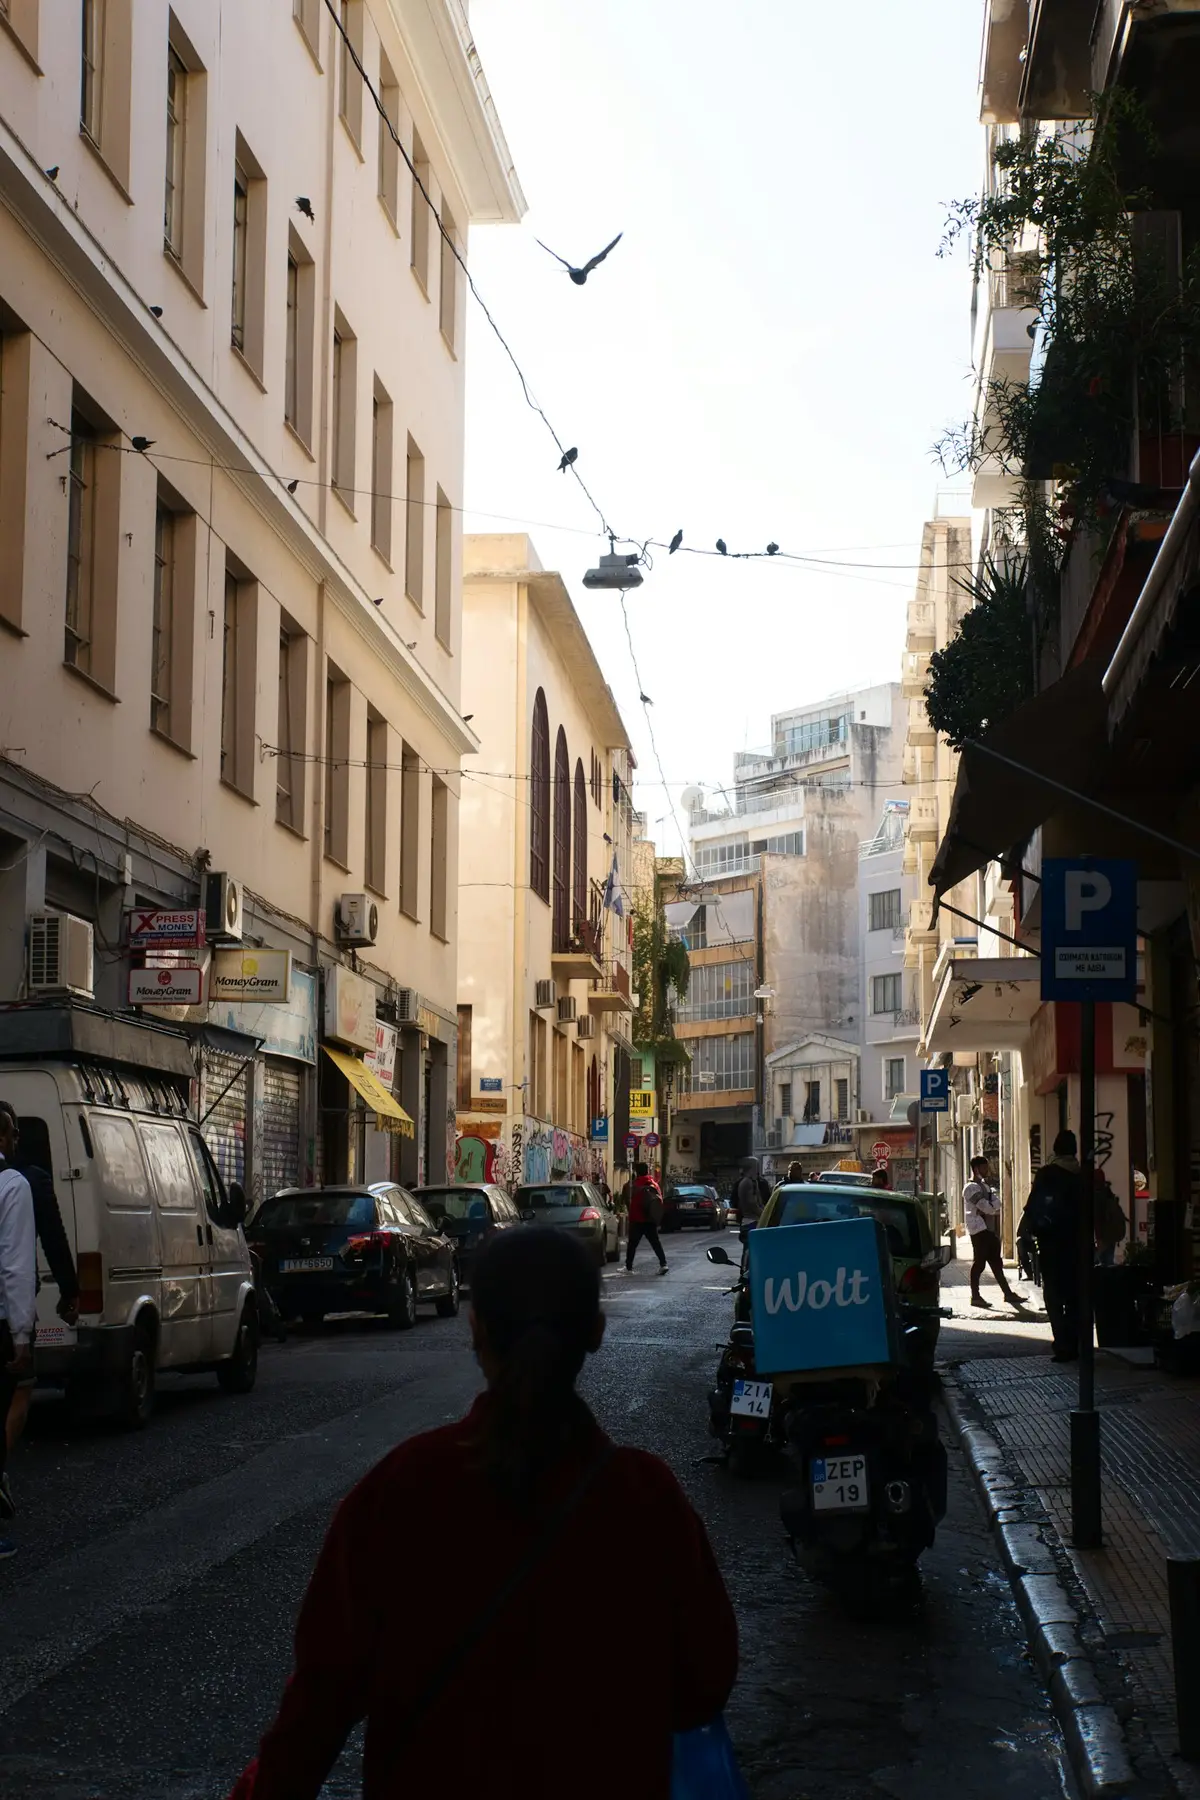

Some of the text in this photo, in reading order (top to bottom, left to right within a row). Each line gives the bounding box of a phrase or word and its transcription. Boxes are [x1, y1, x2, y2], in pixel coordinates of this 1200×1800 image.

[1064, 870, 1112, 931] P
[135, 911, 194, 934] XPRESS
[158, 923, 194, 931] MONEY
[1076, 964, 1085, 972] ΜΕ
[215, 976, 278, 988] MoneyGram
[136, 987, 192, 998] MoneyGram
[927, 1073, 942, 1095] P
[595, 1119, 605, 1131] P
[873, 1146, 889, 1157] STOP
[764, 1266, 871, 1314] Wolt
[744, 1384, 771, 1399] ZIA
[748, 1401, 764, 1414] 14
[827, 1460, 864, 1480] ZEP
[835, 1484, 860, 1503] 19
